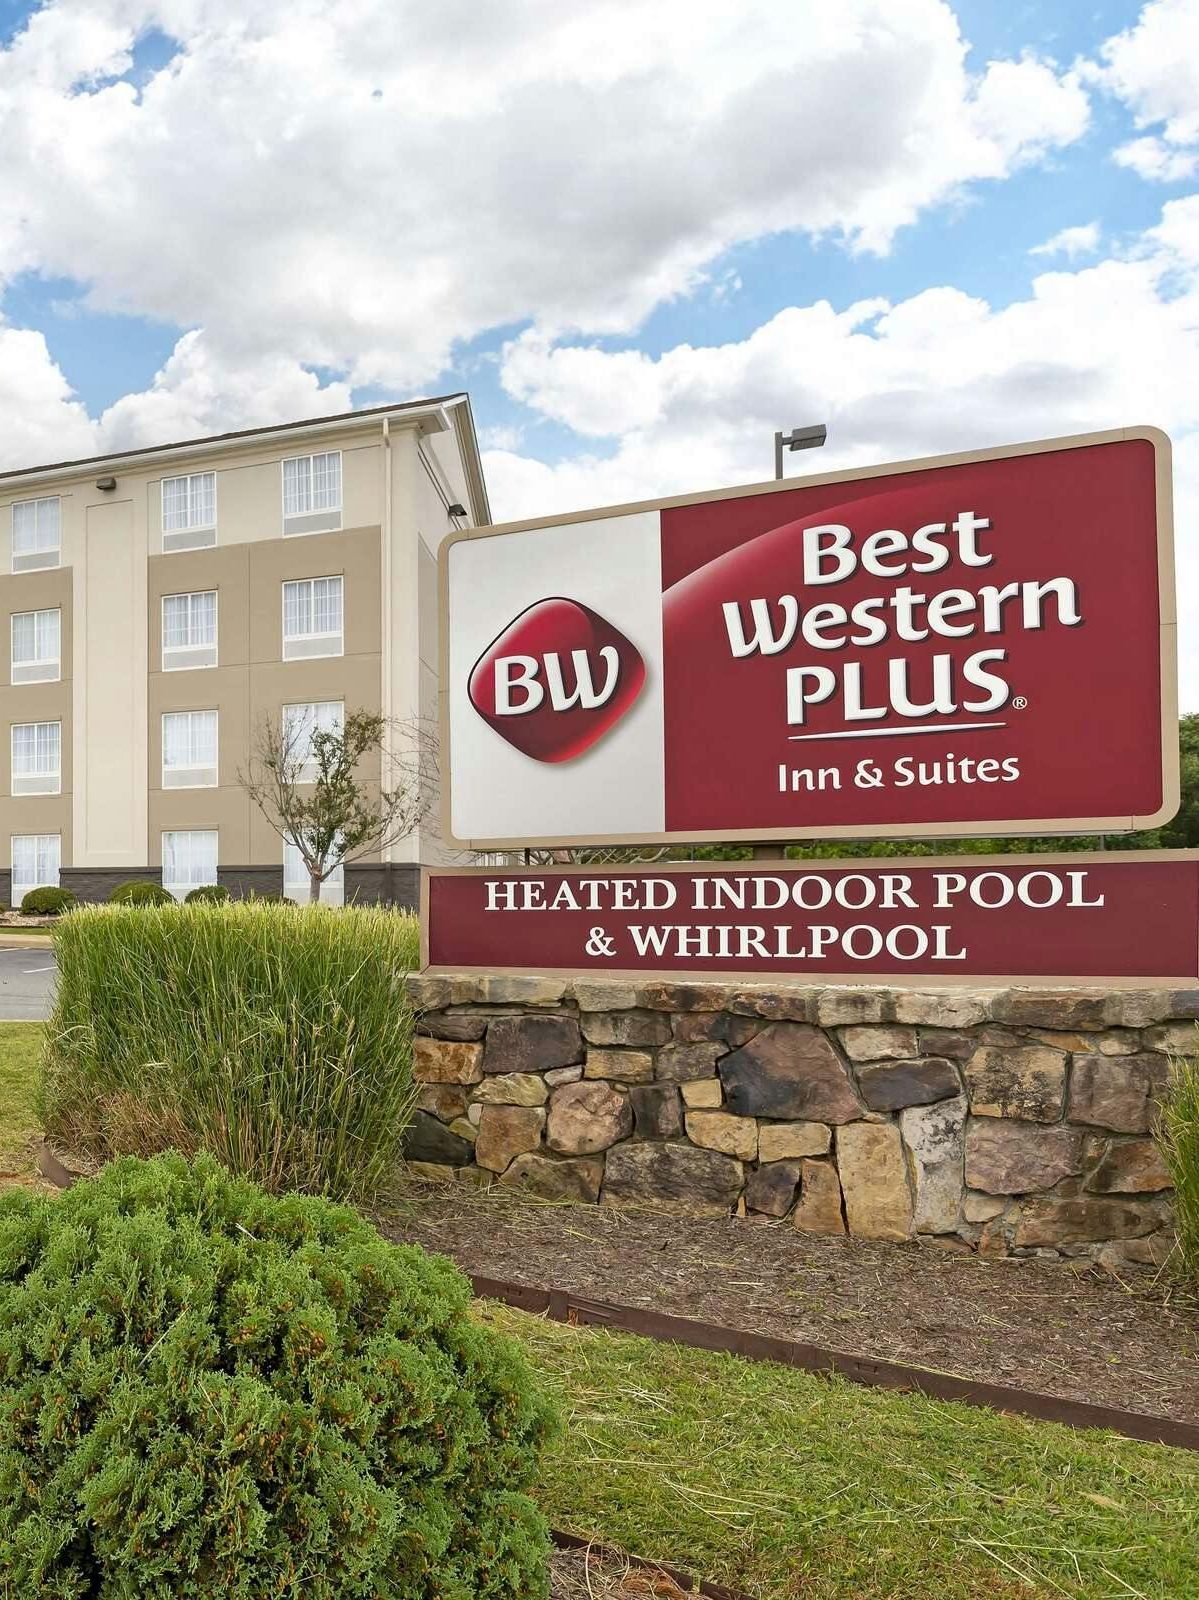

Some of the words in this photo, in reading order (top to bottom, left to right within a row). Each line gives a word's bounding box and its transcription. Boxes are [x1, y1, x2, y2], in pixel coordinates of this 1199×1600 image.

[802, 511, 993, 585] Best
[722, 577, 1082, 658] Western
[494, 645, 619, 715] BW
[779, 763, 842, 792] Inn
[854, 759, 884, 788] &
[894, 753, 1020, 787] Suites
[484, 878, 677, 911] HEATED
[690, 873, 920, 910] INDOOR
[932, 871, 1105, 909] POOL
[585, 926, 617, 957] &
[627, 924, 967, 960] WHIRLPOOL
